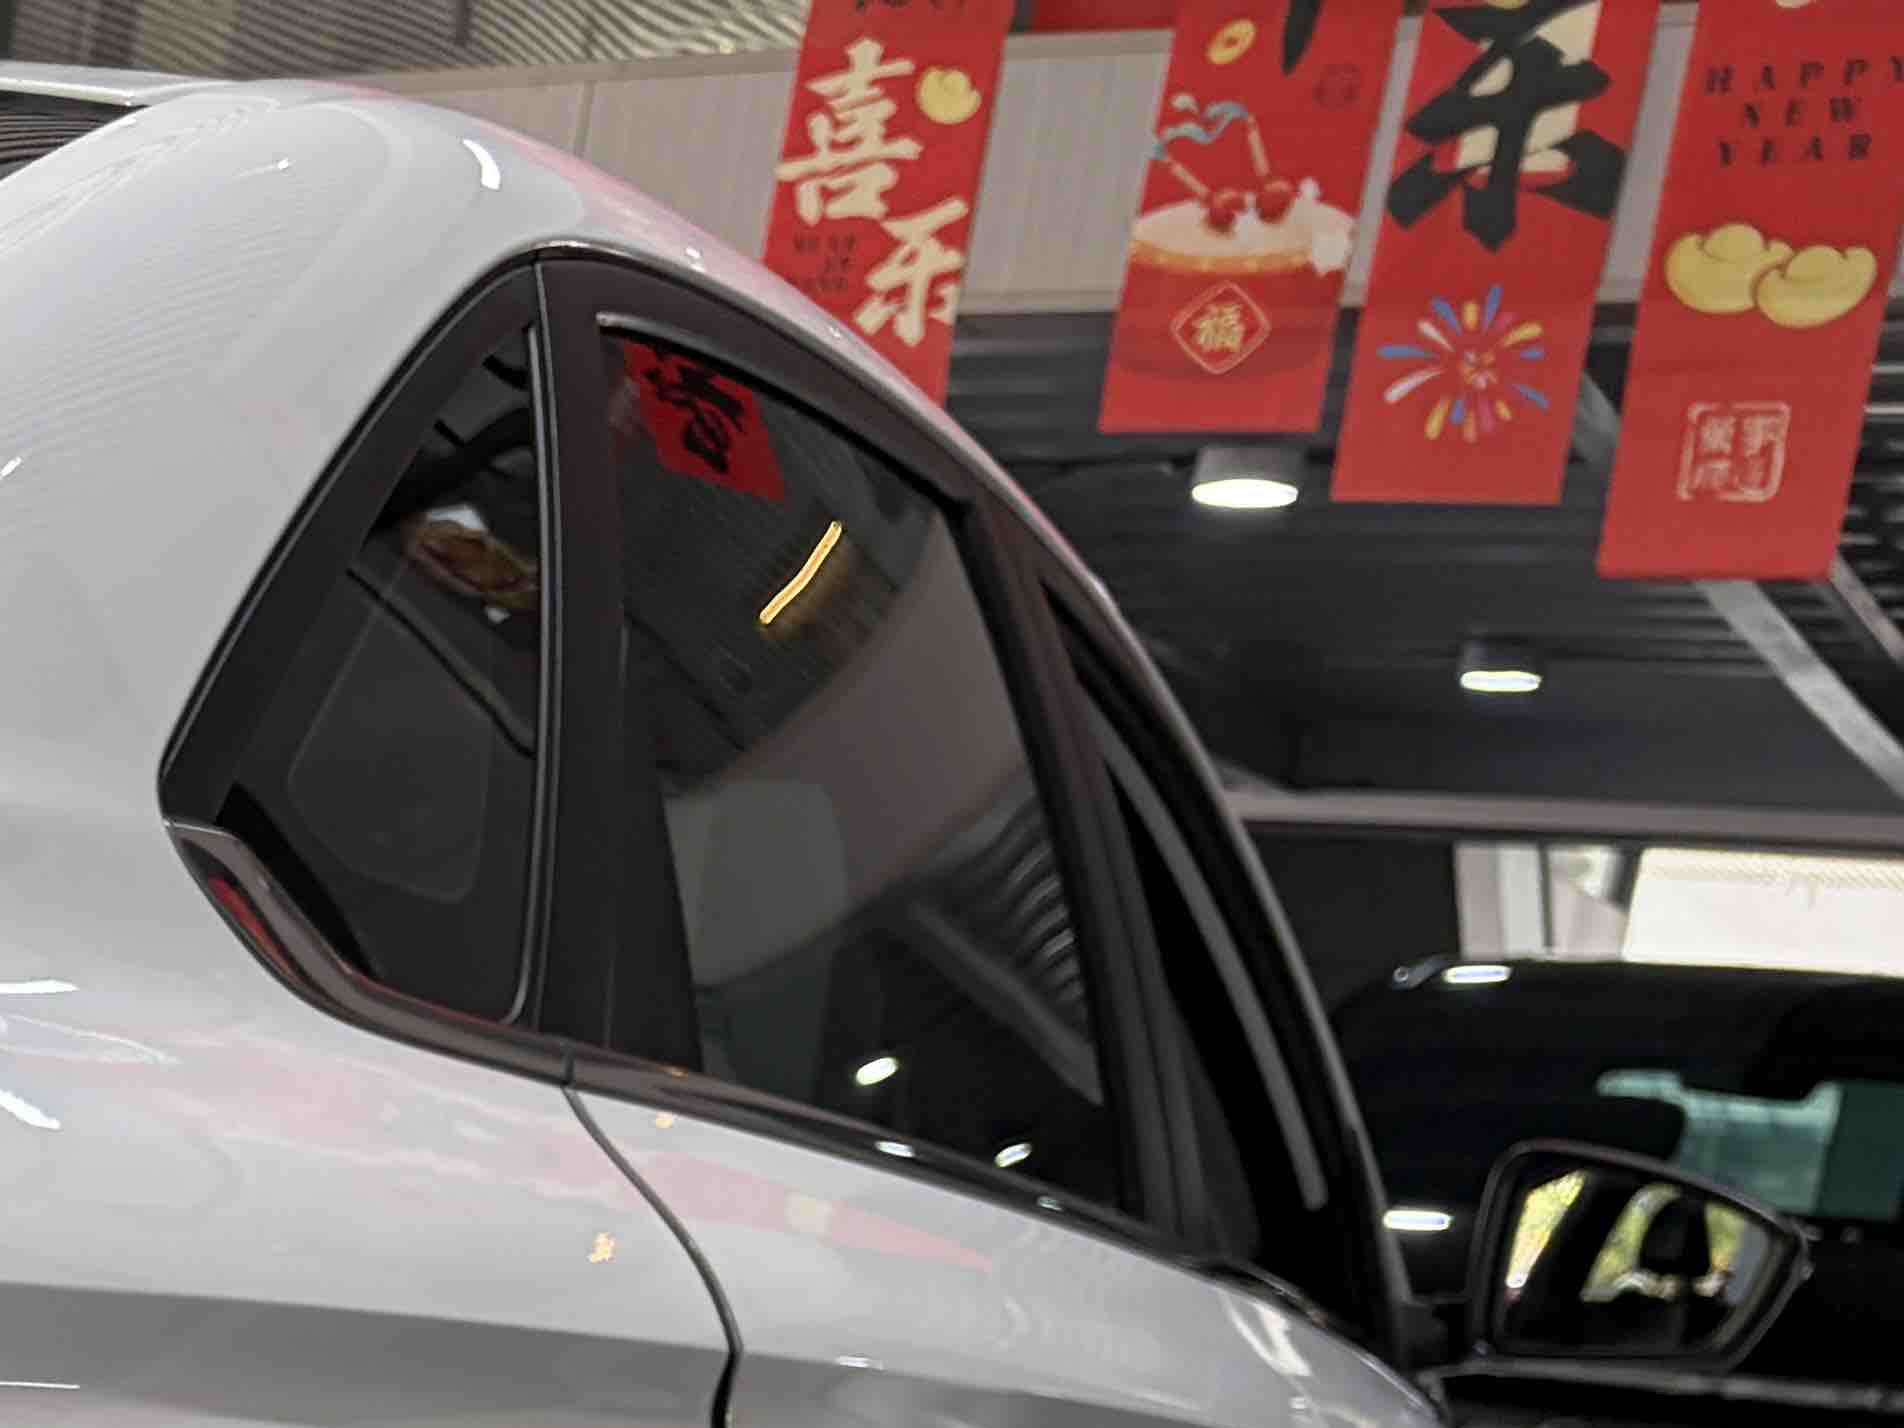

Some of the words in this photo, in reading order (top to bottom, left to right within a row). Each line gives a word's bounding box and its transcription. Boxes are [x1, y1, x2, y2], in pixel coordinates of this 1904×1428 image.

[1742, 96, 1855, 127] NEW
[1717, 131, 1873, 167] YEAR
[1193, 303, 1244, 354] 福
